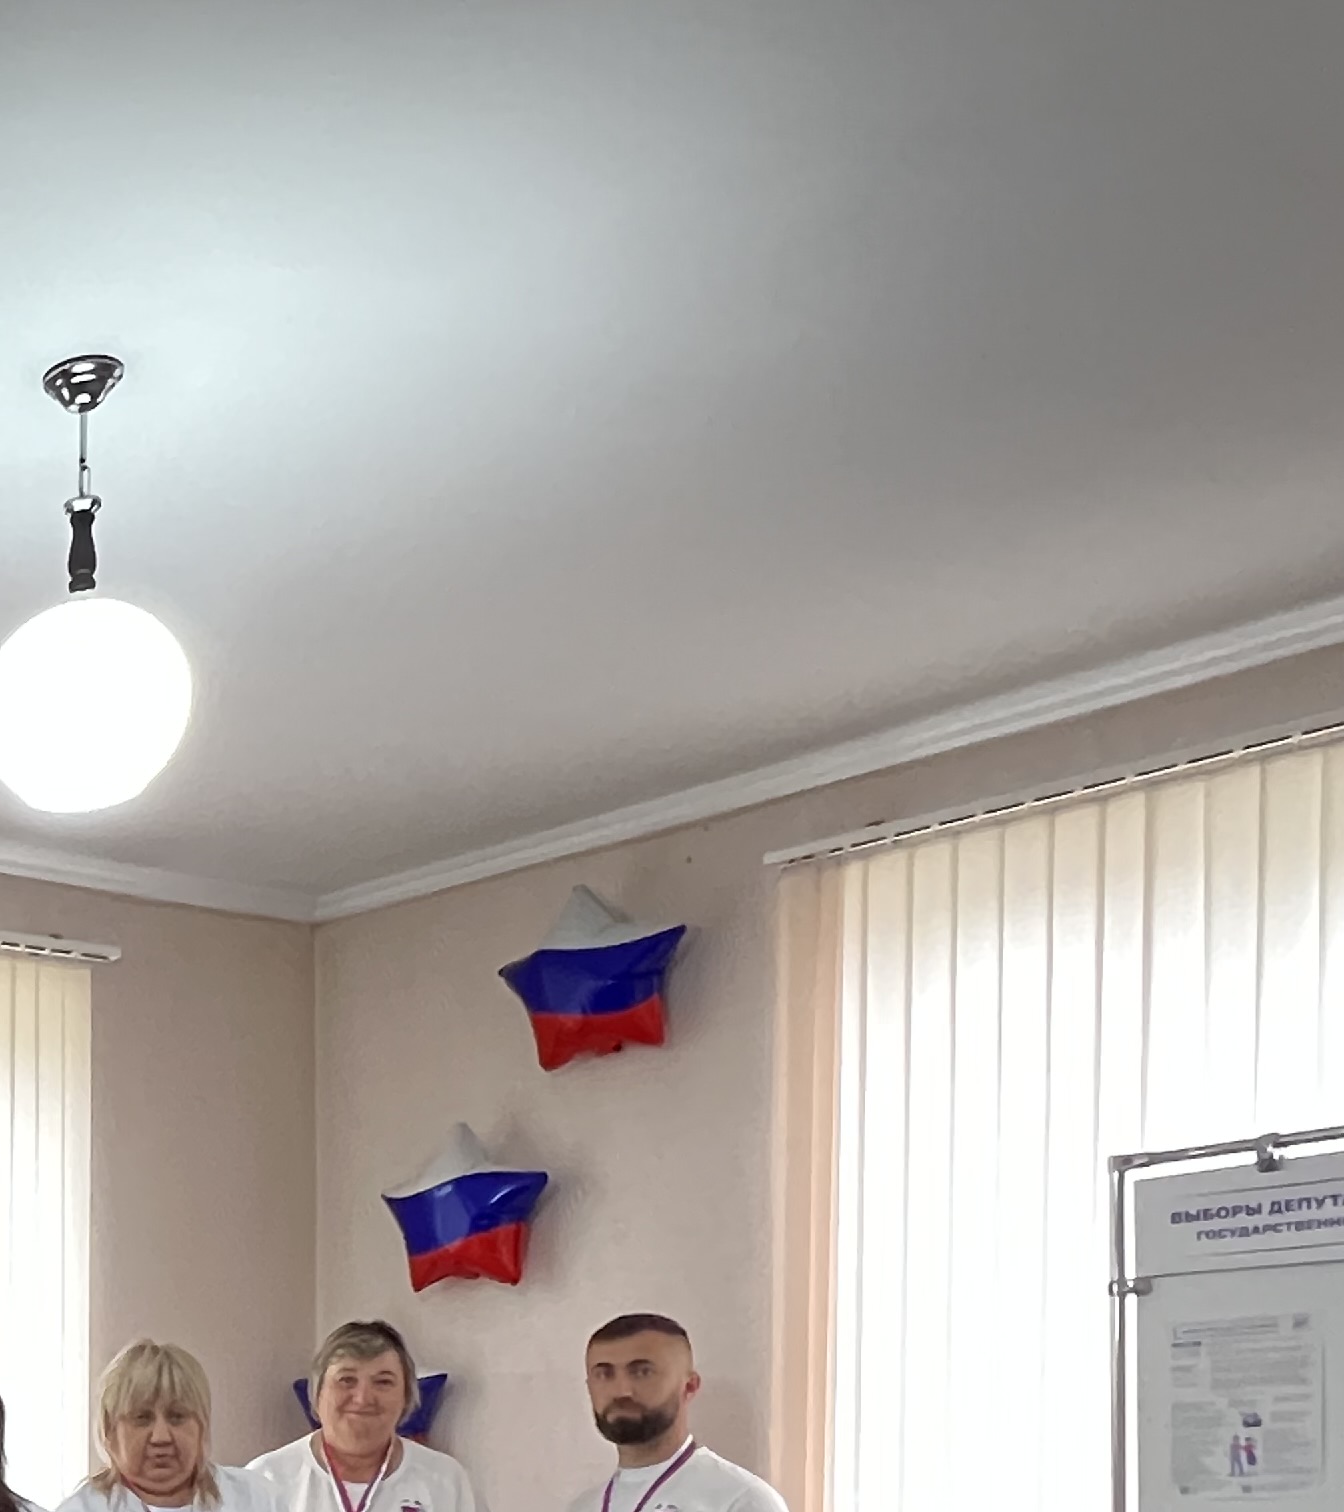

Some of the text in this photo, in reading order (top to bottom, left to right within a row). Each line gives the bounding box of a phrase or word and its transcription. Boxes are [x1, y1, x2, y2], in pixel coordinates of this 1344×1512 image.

[1170, 1193, 1344, 1224] ВЫБОРЫ ДЕПУТ
[1196, 1216, 1344, 1241] ГОСУДАРСТВЕНН
